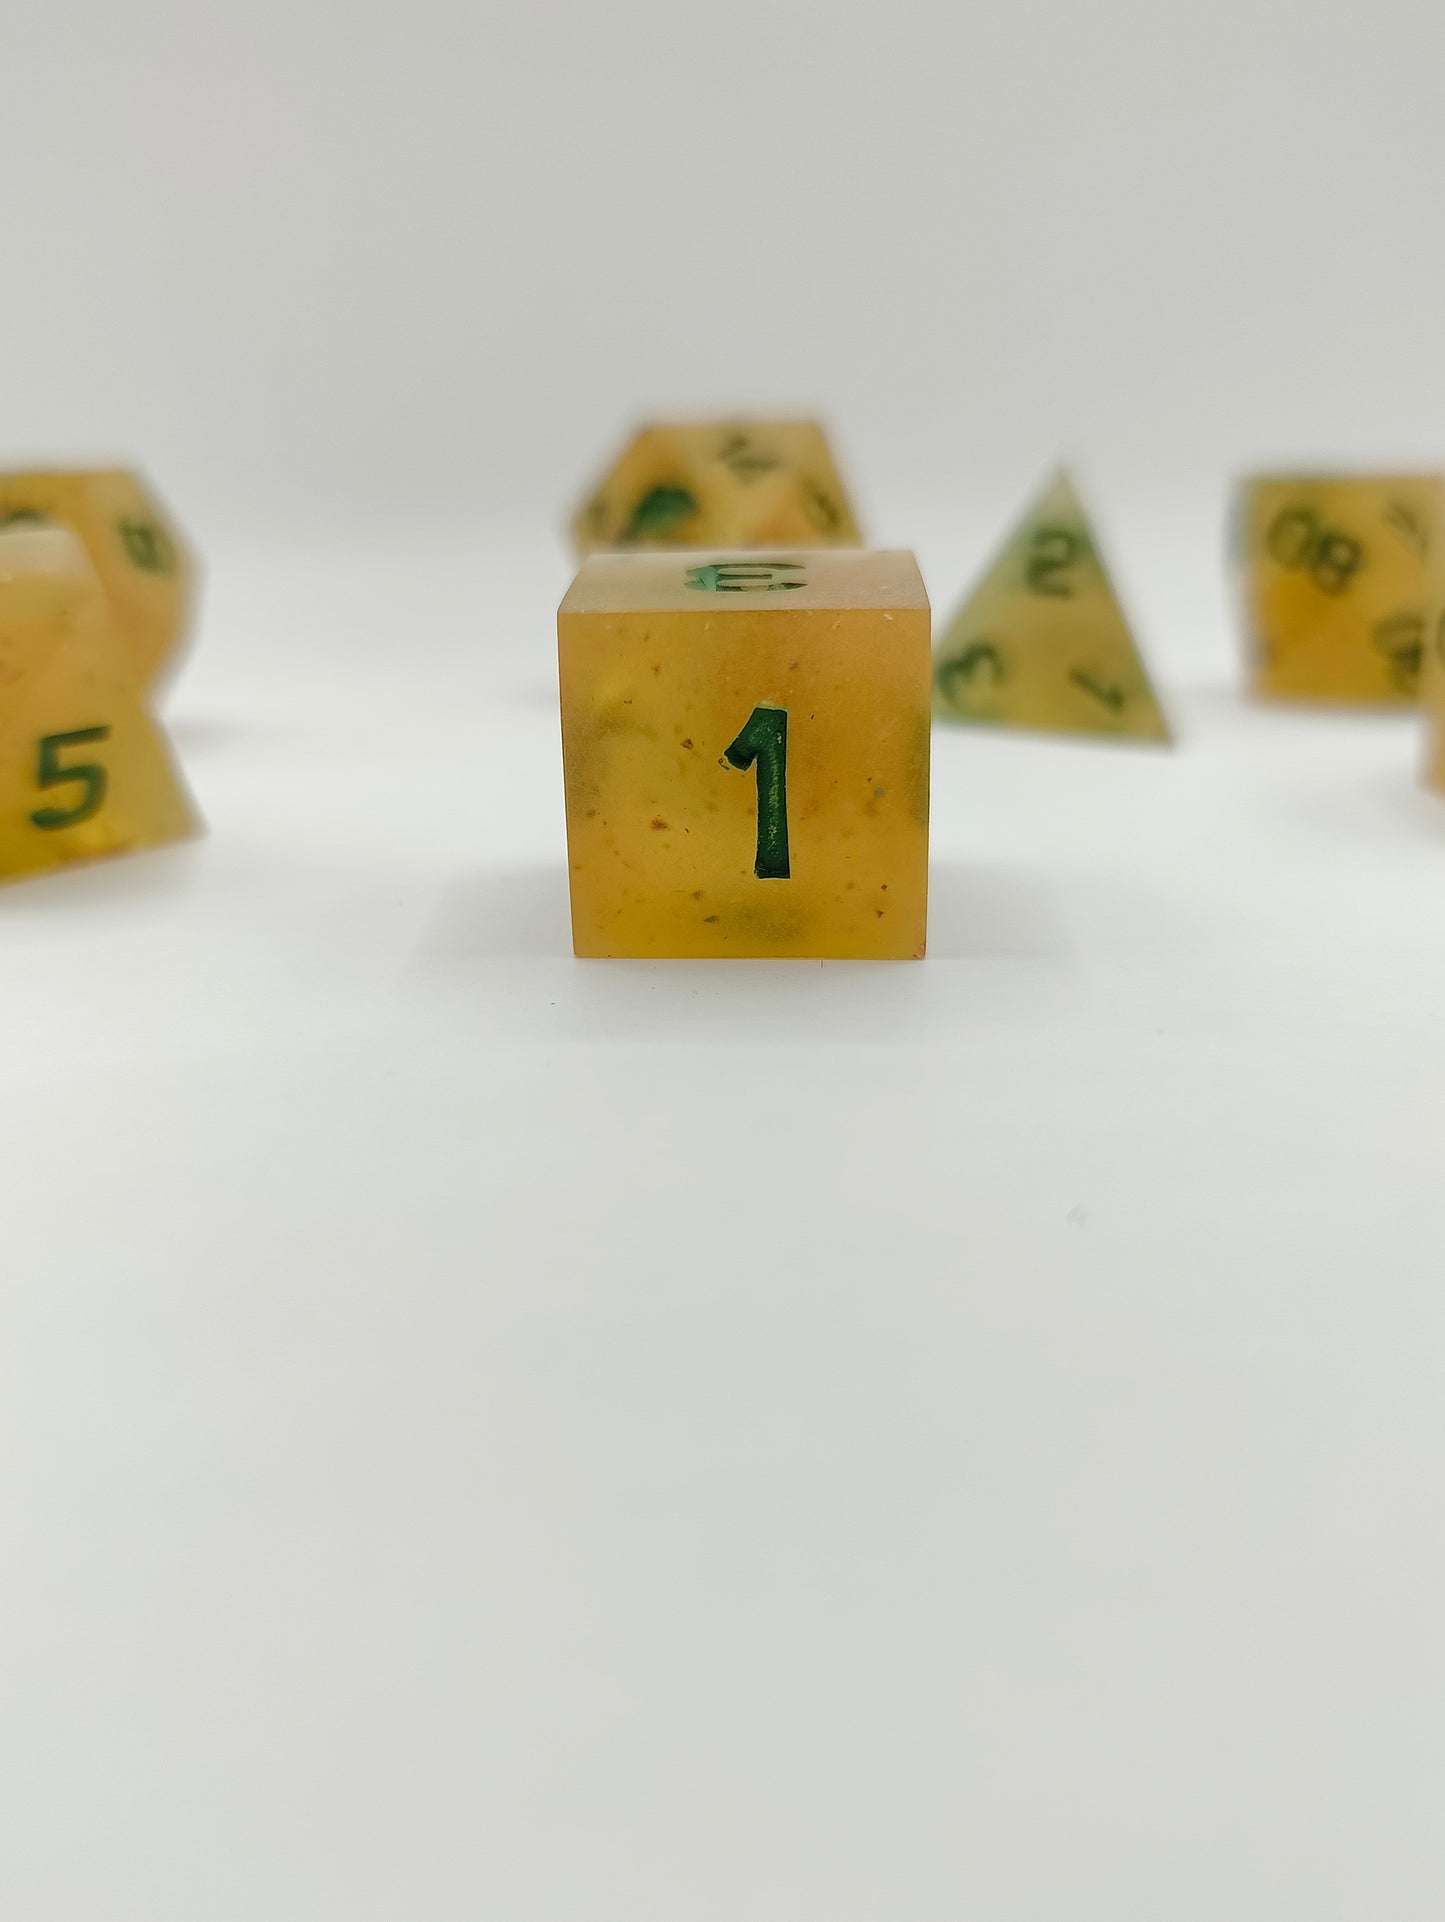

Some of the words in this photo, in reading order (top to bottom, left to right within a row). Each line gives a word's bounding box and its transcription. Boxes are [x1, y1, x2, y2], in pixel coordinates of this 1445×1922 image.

[684, 562, 808, 592] 3
[1026, 528, 1077, 598] 2
[30, 724, 111, 829] 5
[723, 706, 790, 879] 1
